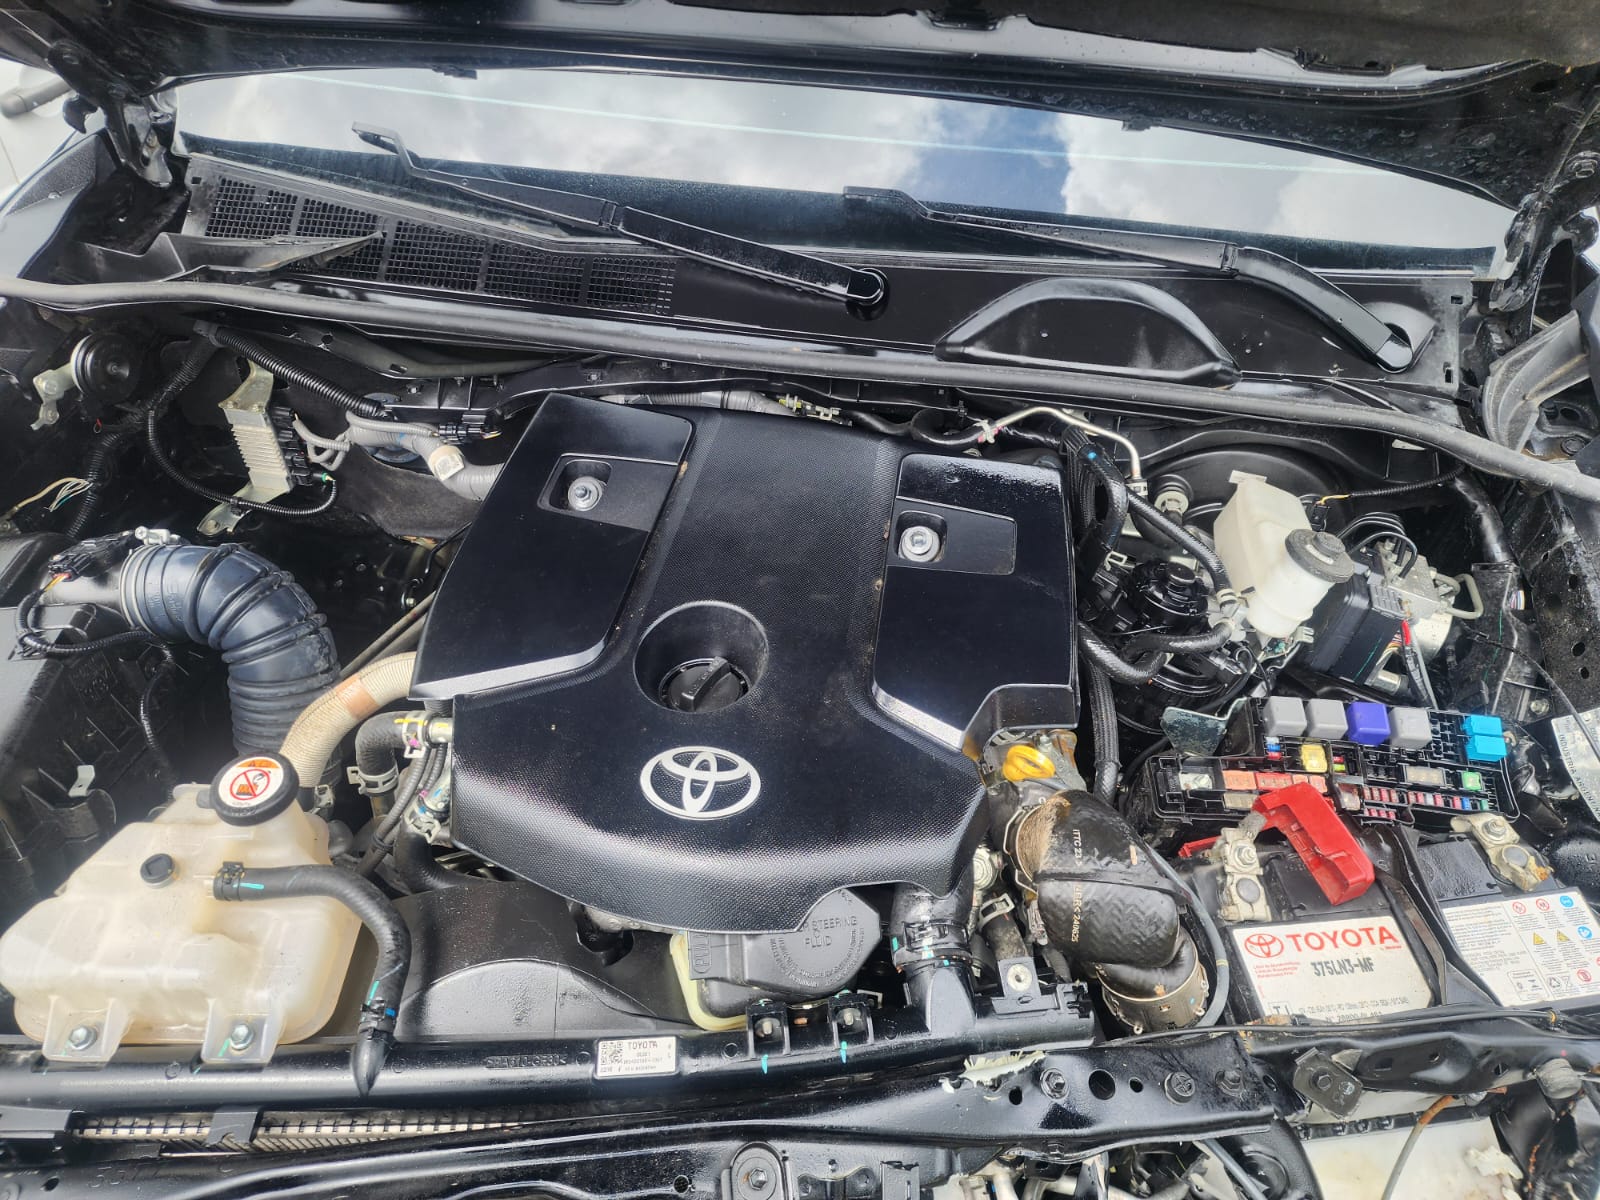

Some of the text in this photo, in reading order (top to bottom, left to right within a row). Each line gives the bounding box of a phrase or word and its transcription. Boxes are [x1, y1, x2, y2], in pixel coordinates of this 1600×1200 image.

[812, 916, 857, 930] STEERING
[805, 935, 832, 948] FLUID
[1286, 926, 1399, 952] TOYOTA
[1311, 957, 1375, 976] 375LN3-MF
[627, 1040, 658, 1051] TOYOTA
